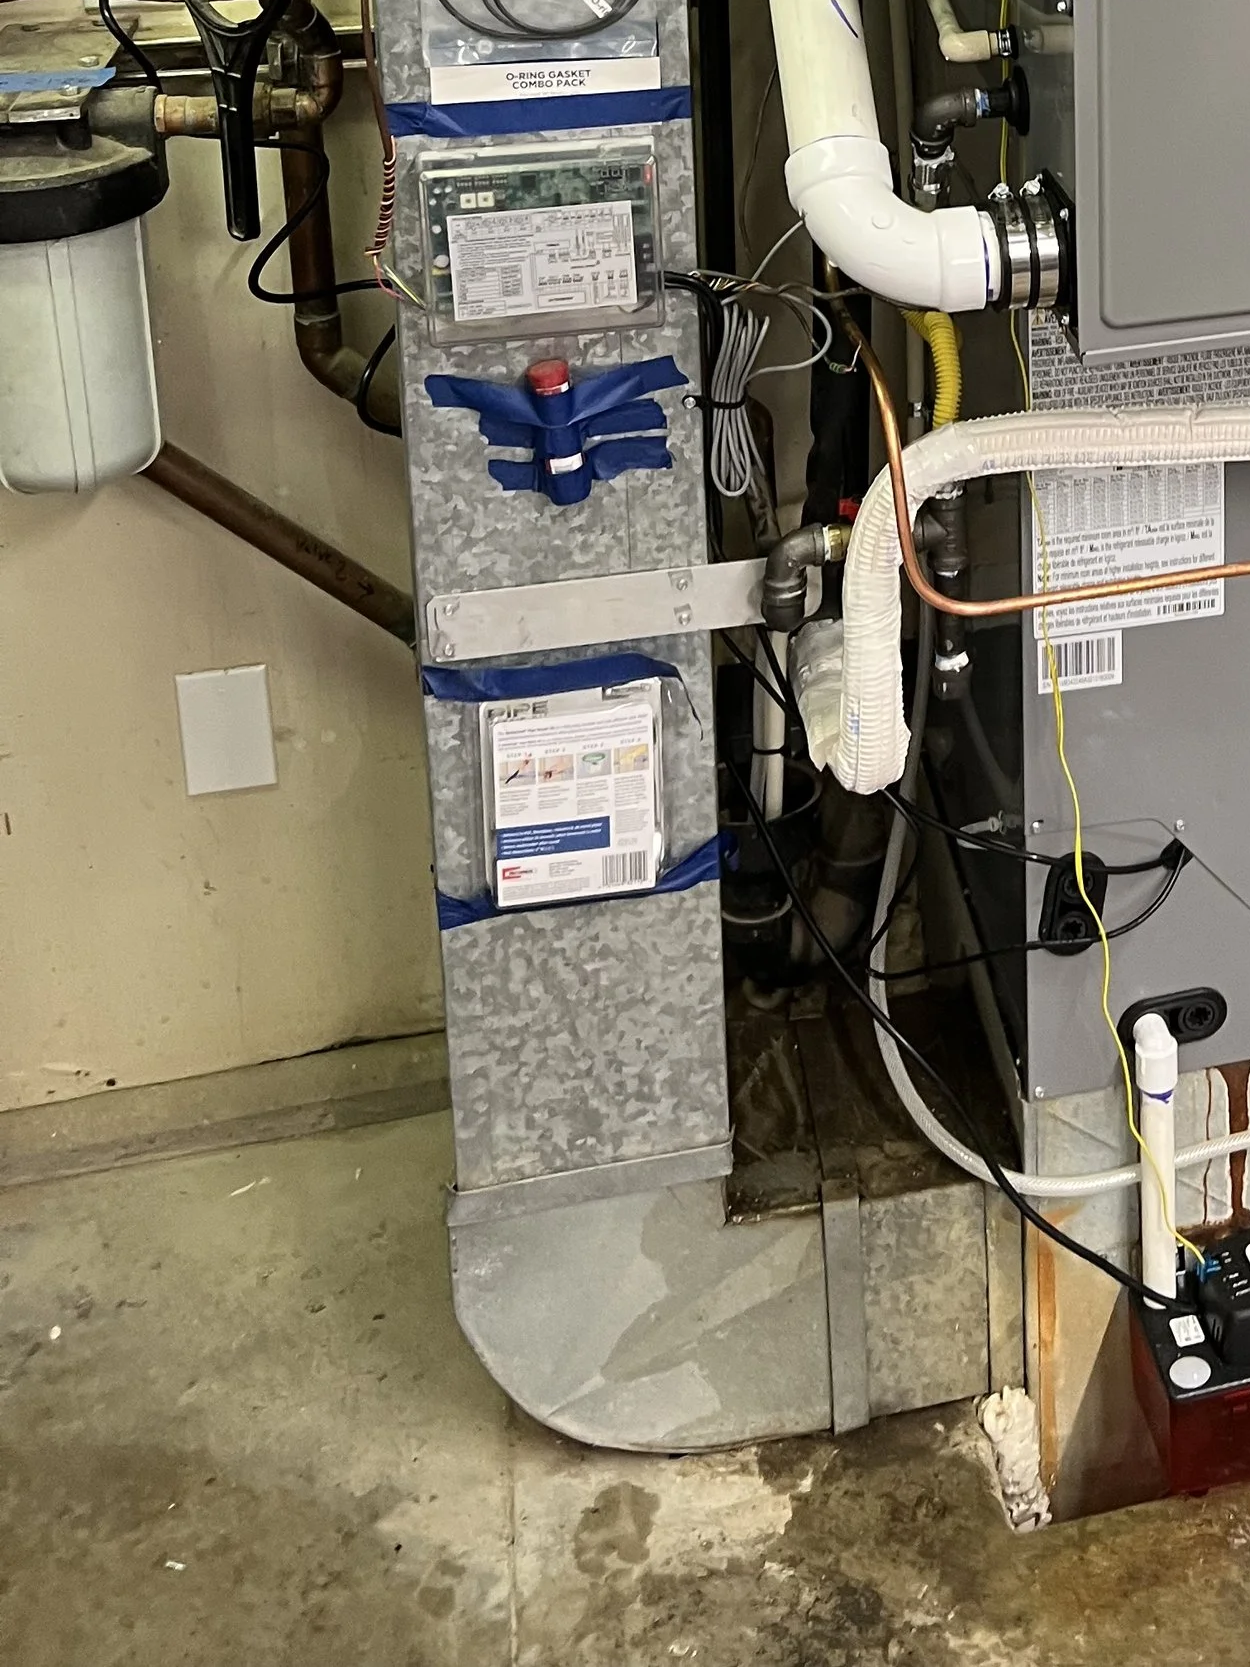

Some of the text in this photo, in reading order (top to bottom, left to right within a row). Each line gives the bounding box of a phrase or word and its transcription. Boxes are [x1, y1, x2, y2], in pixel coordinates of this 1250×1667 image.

[506, 68, 592, 82] O-RING GASKET
[512, 78, 587, 91] COMBO PACK
